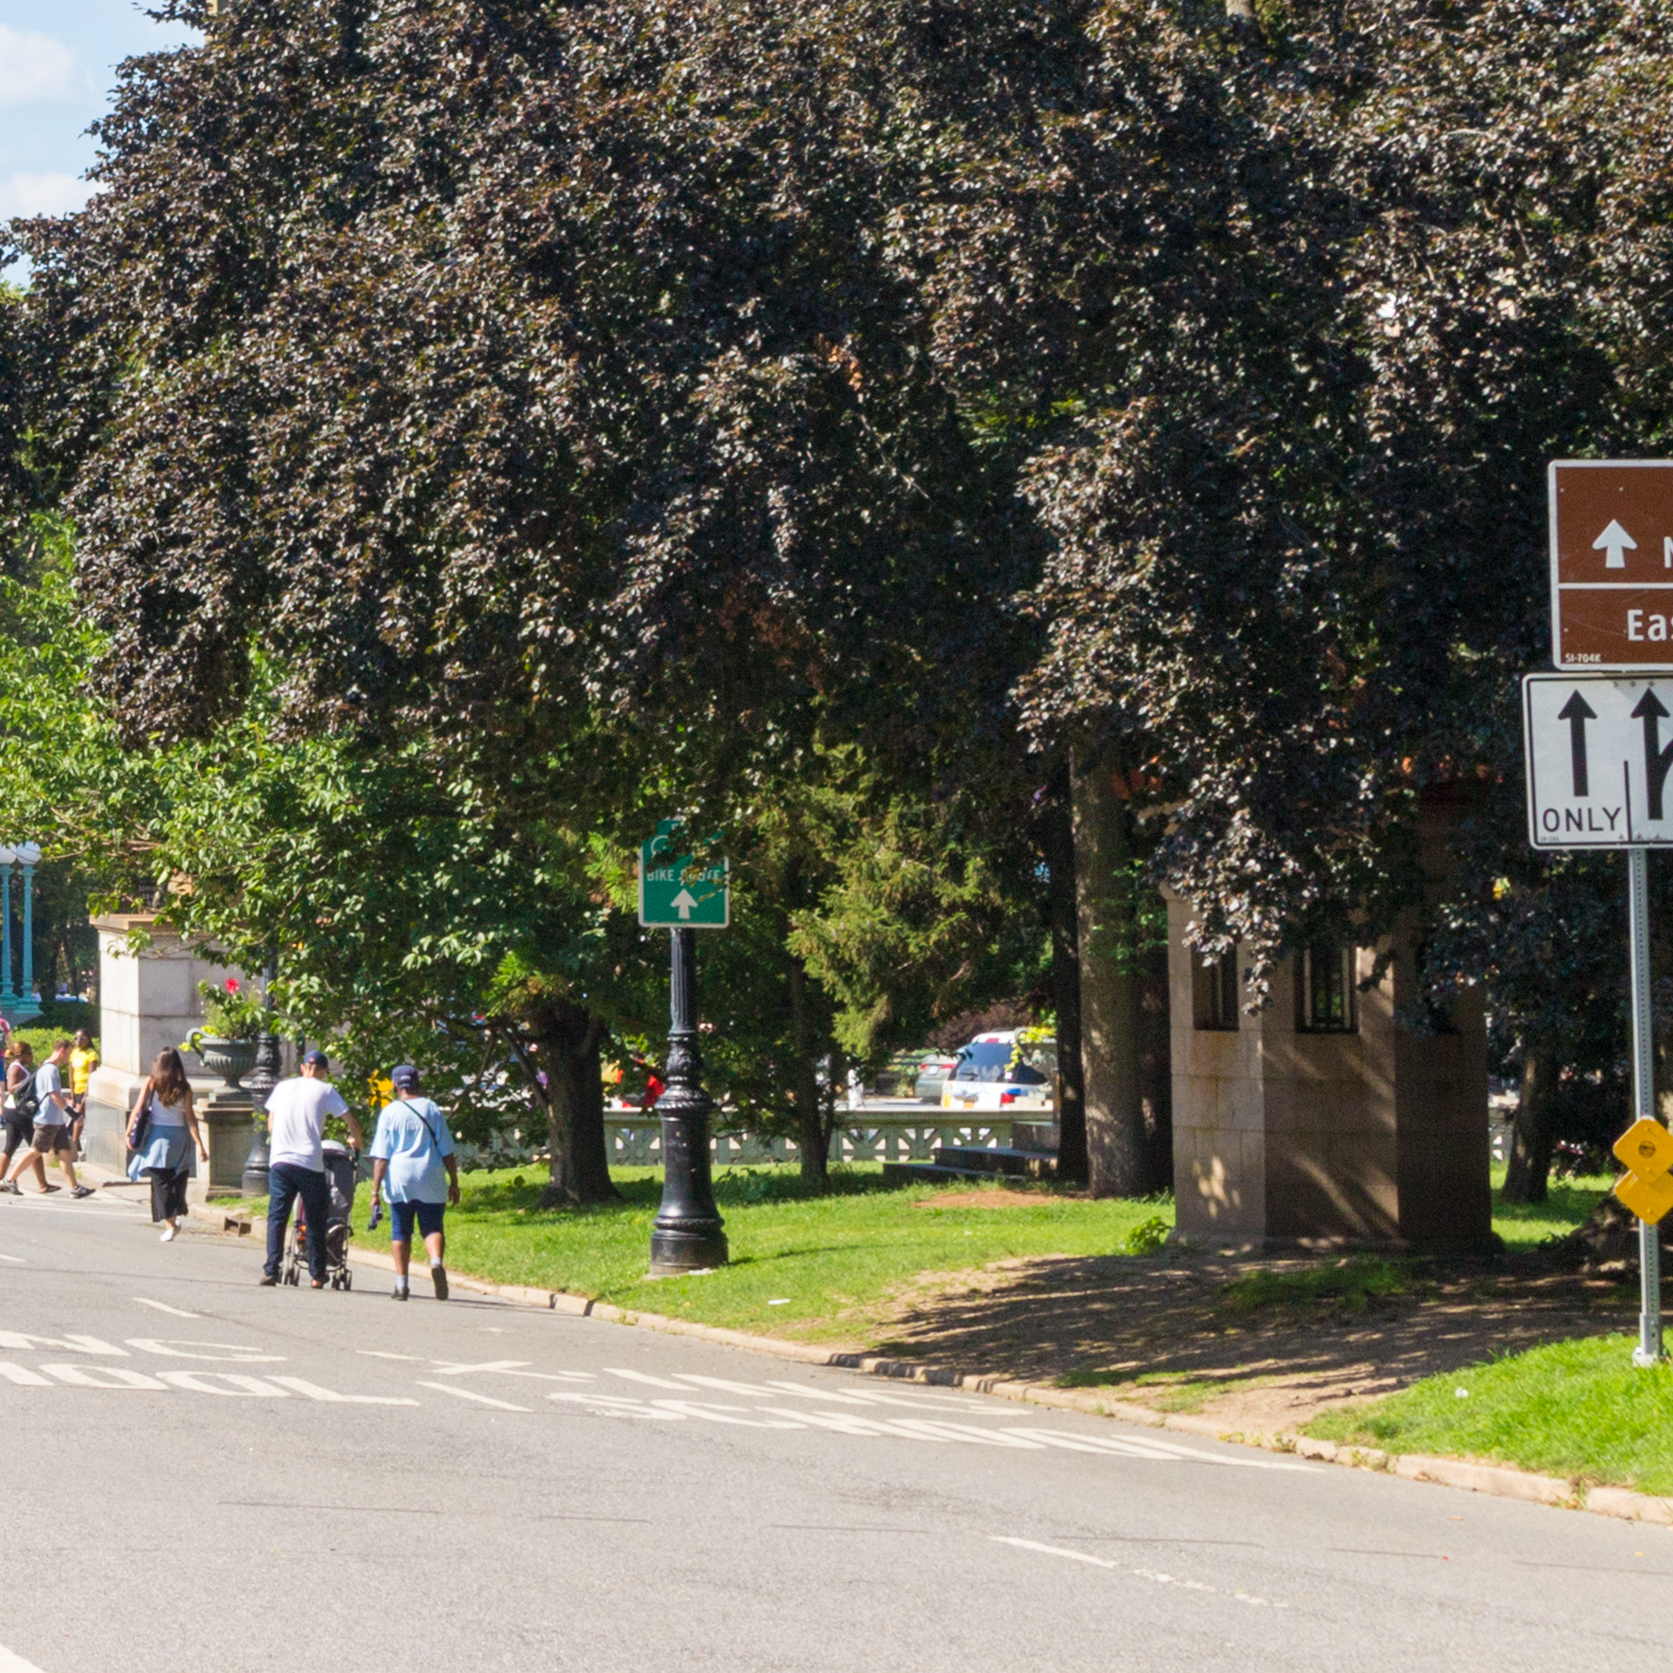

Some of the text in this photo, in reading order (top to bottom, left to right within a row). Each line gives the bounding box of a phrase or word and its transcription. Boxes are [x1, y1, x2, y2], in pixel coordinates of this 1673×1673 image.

[1564, 652, 1602, 664] SI-704K
[1542, 807, 1622, 832] ONLY
[547, 1391, 1326, 1473] SCHOOL
